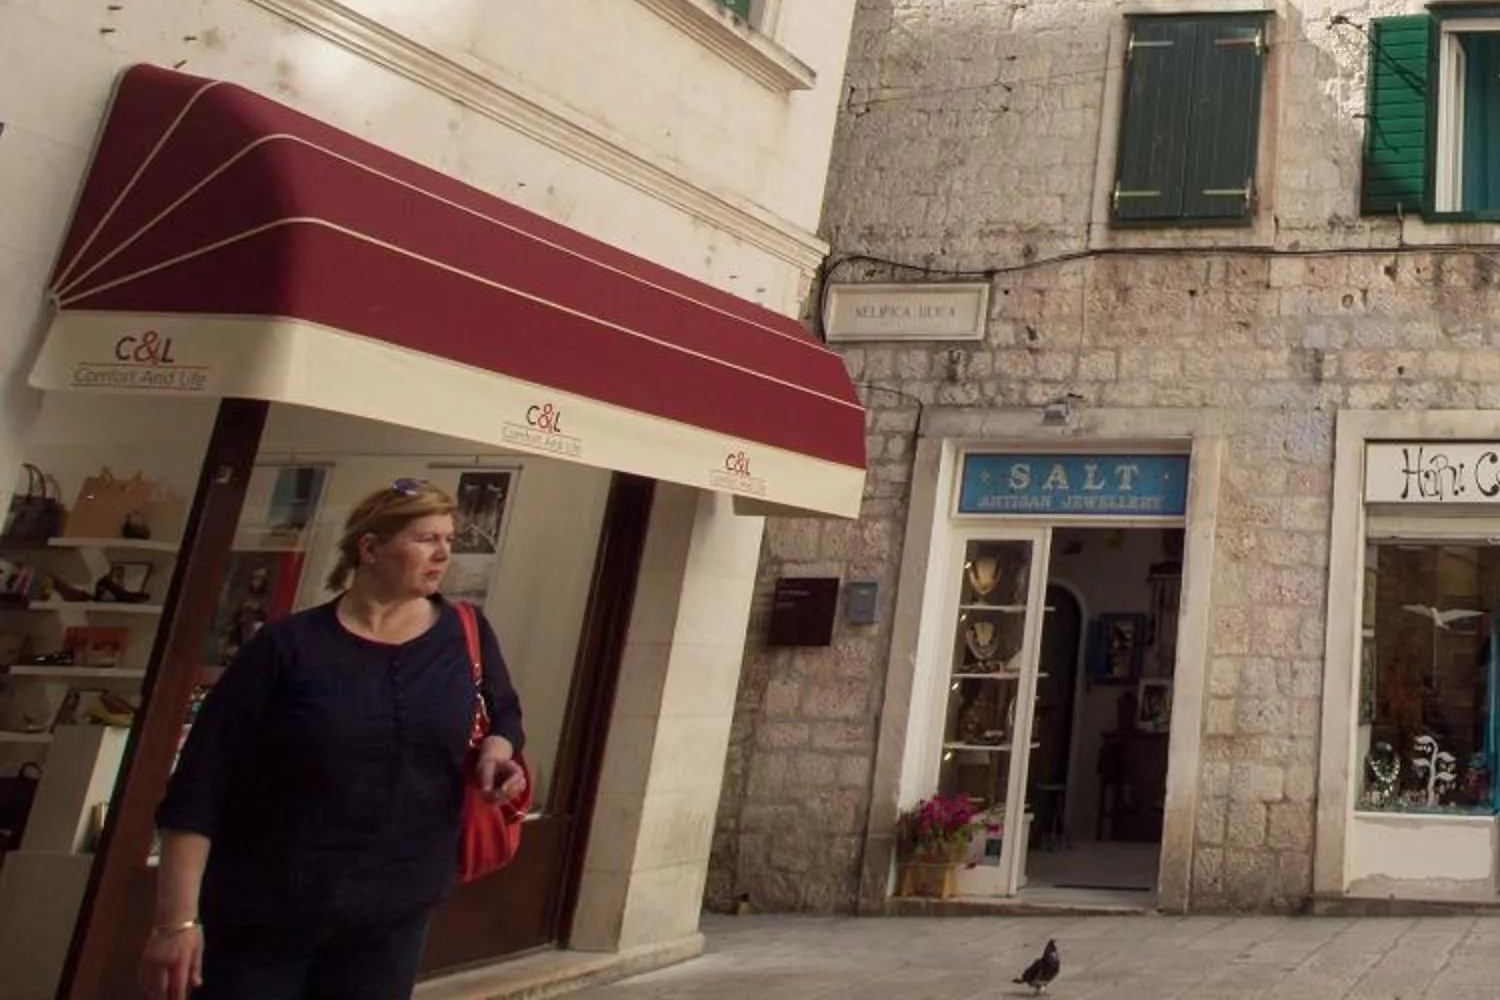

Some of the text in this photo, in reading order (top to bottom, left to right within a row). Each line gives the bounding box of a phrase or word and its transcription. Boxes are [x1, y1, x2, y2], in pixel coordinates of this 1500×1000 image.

[115, 330, 175, 366] C&L
[526, 403, 561, 434] C&L
[725, 450, 751, 477] C&L
[1009, 462, 1139, 491] SALT
